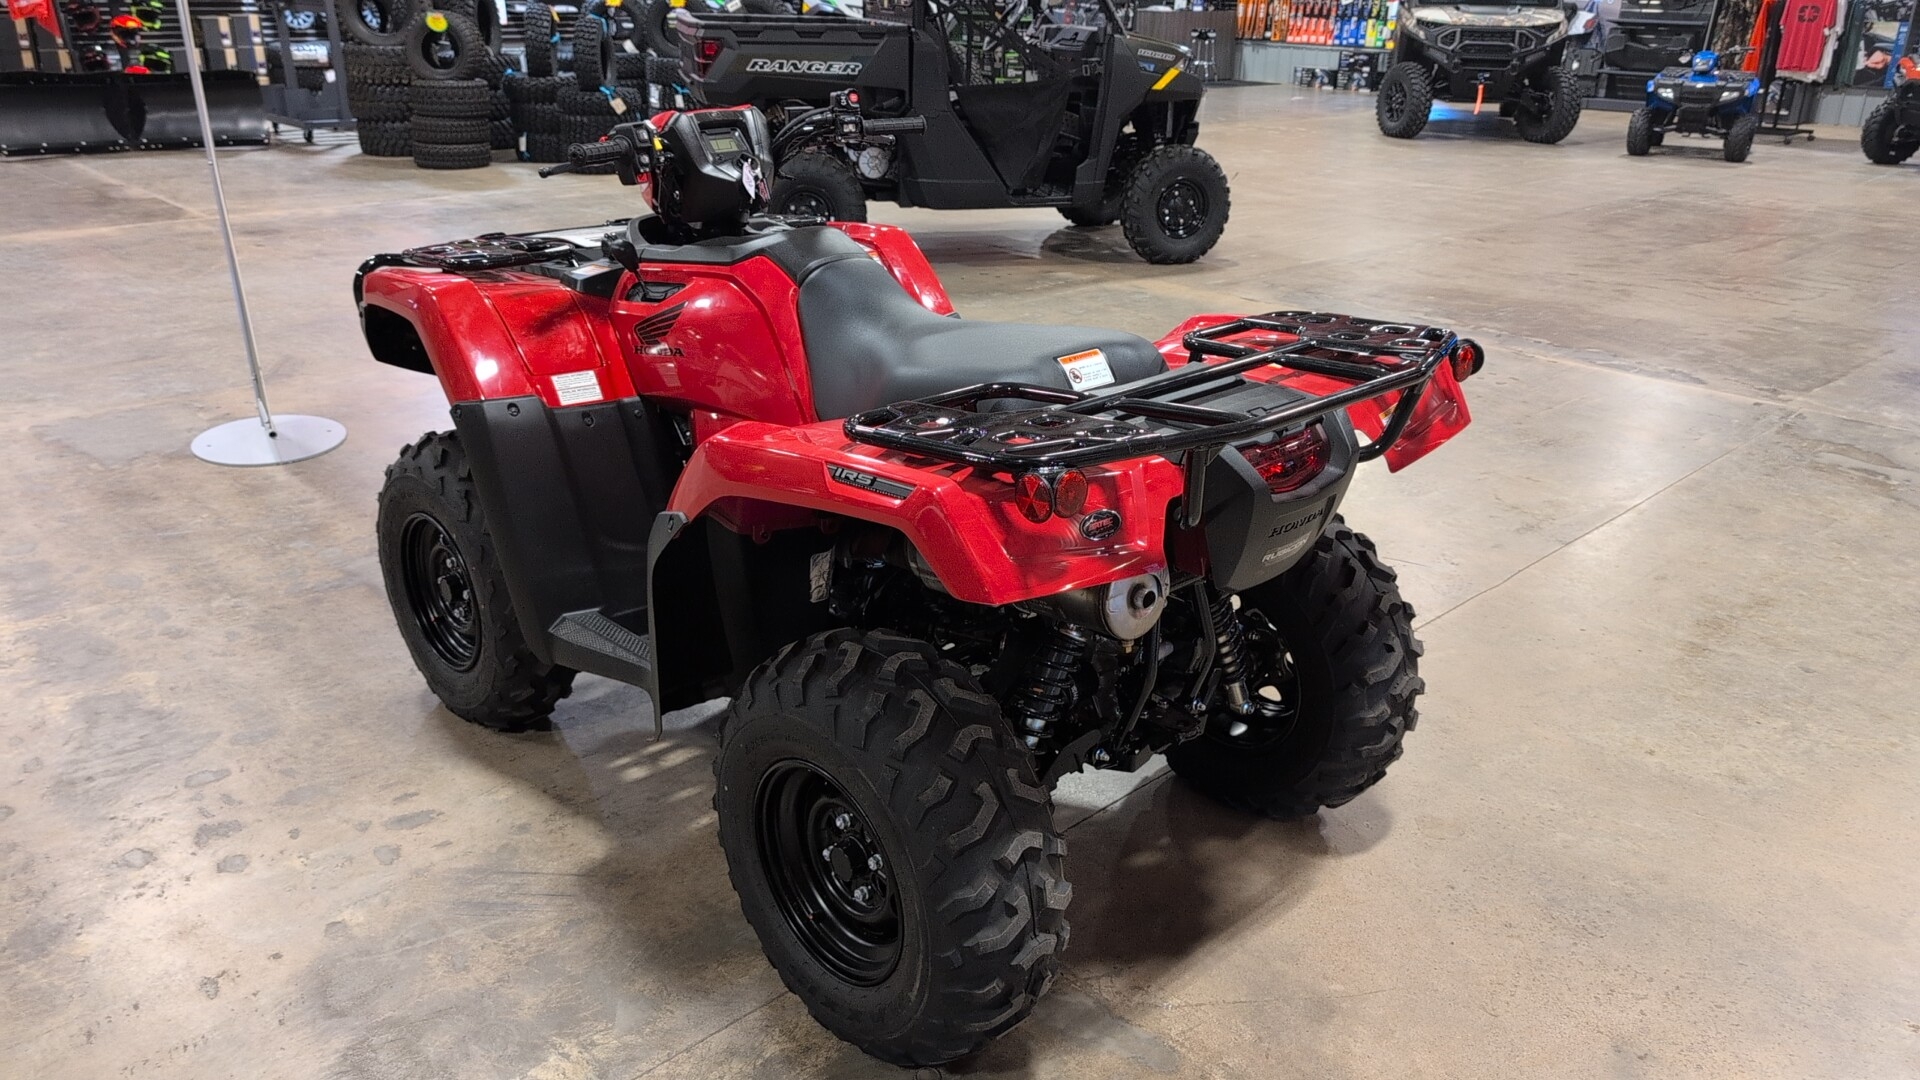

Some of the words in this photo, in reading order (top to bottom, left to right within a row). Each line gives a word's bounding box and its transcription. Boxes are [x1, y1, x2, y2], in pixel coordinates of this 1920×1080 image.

[746, 58, 863, 75] RANGER
[635, 346, 684, 357] HONDA
[834, 467, 874, 485] IRS
[1268, 509, 1324, 538] HONDA
